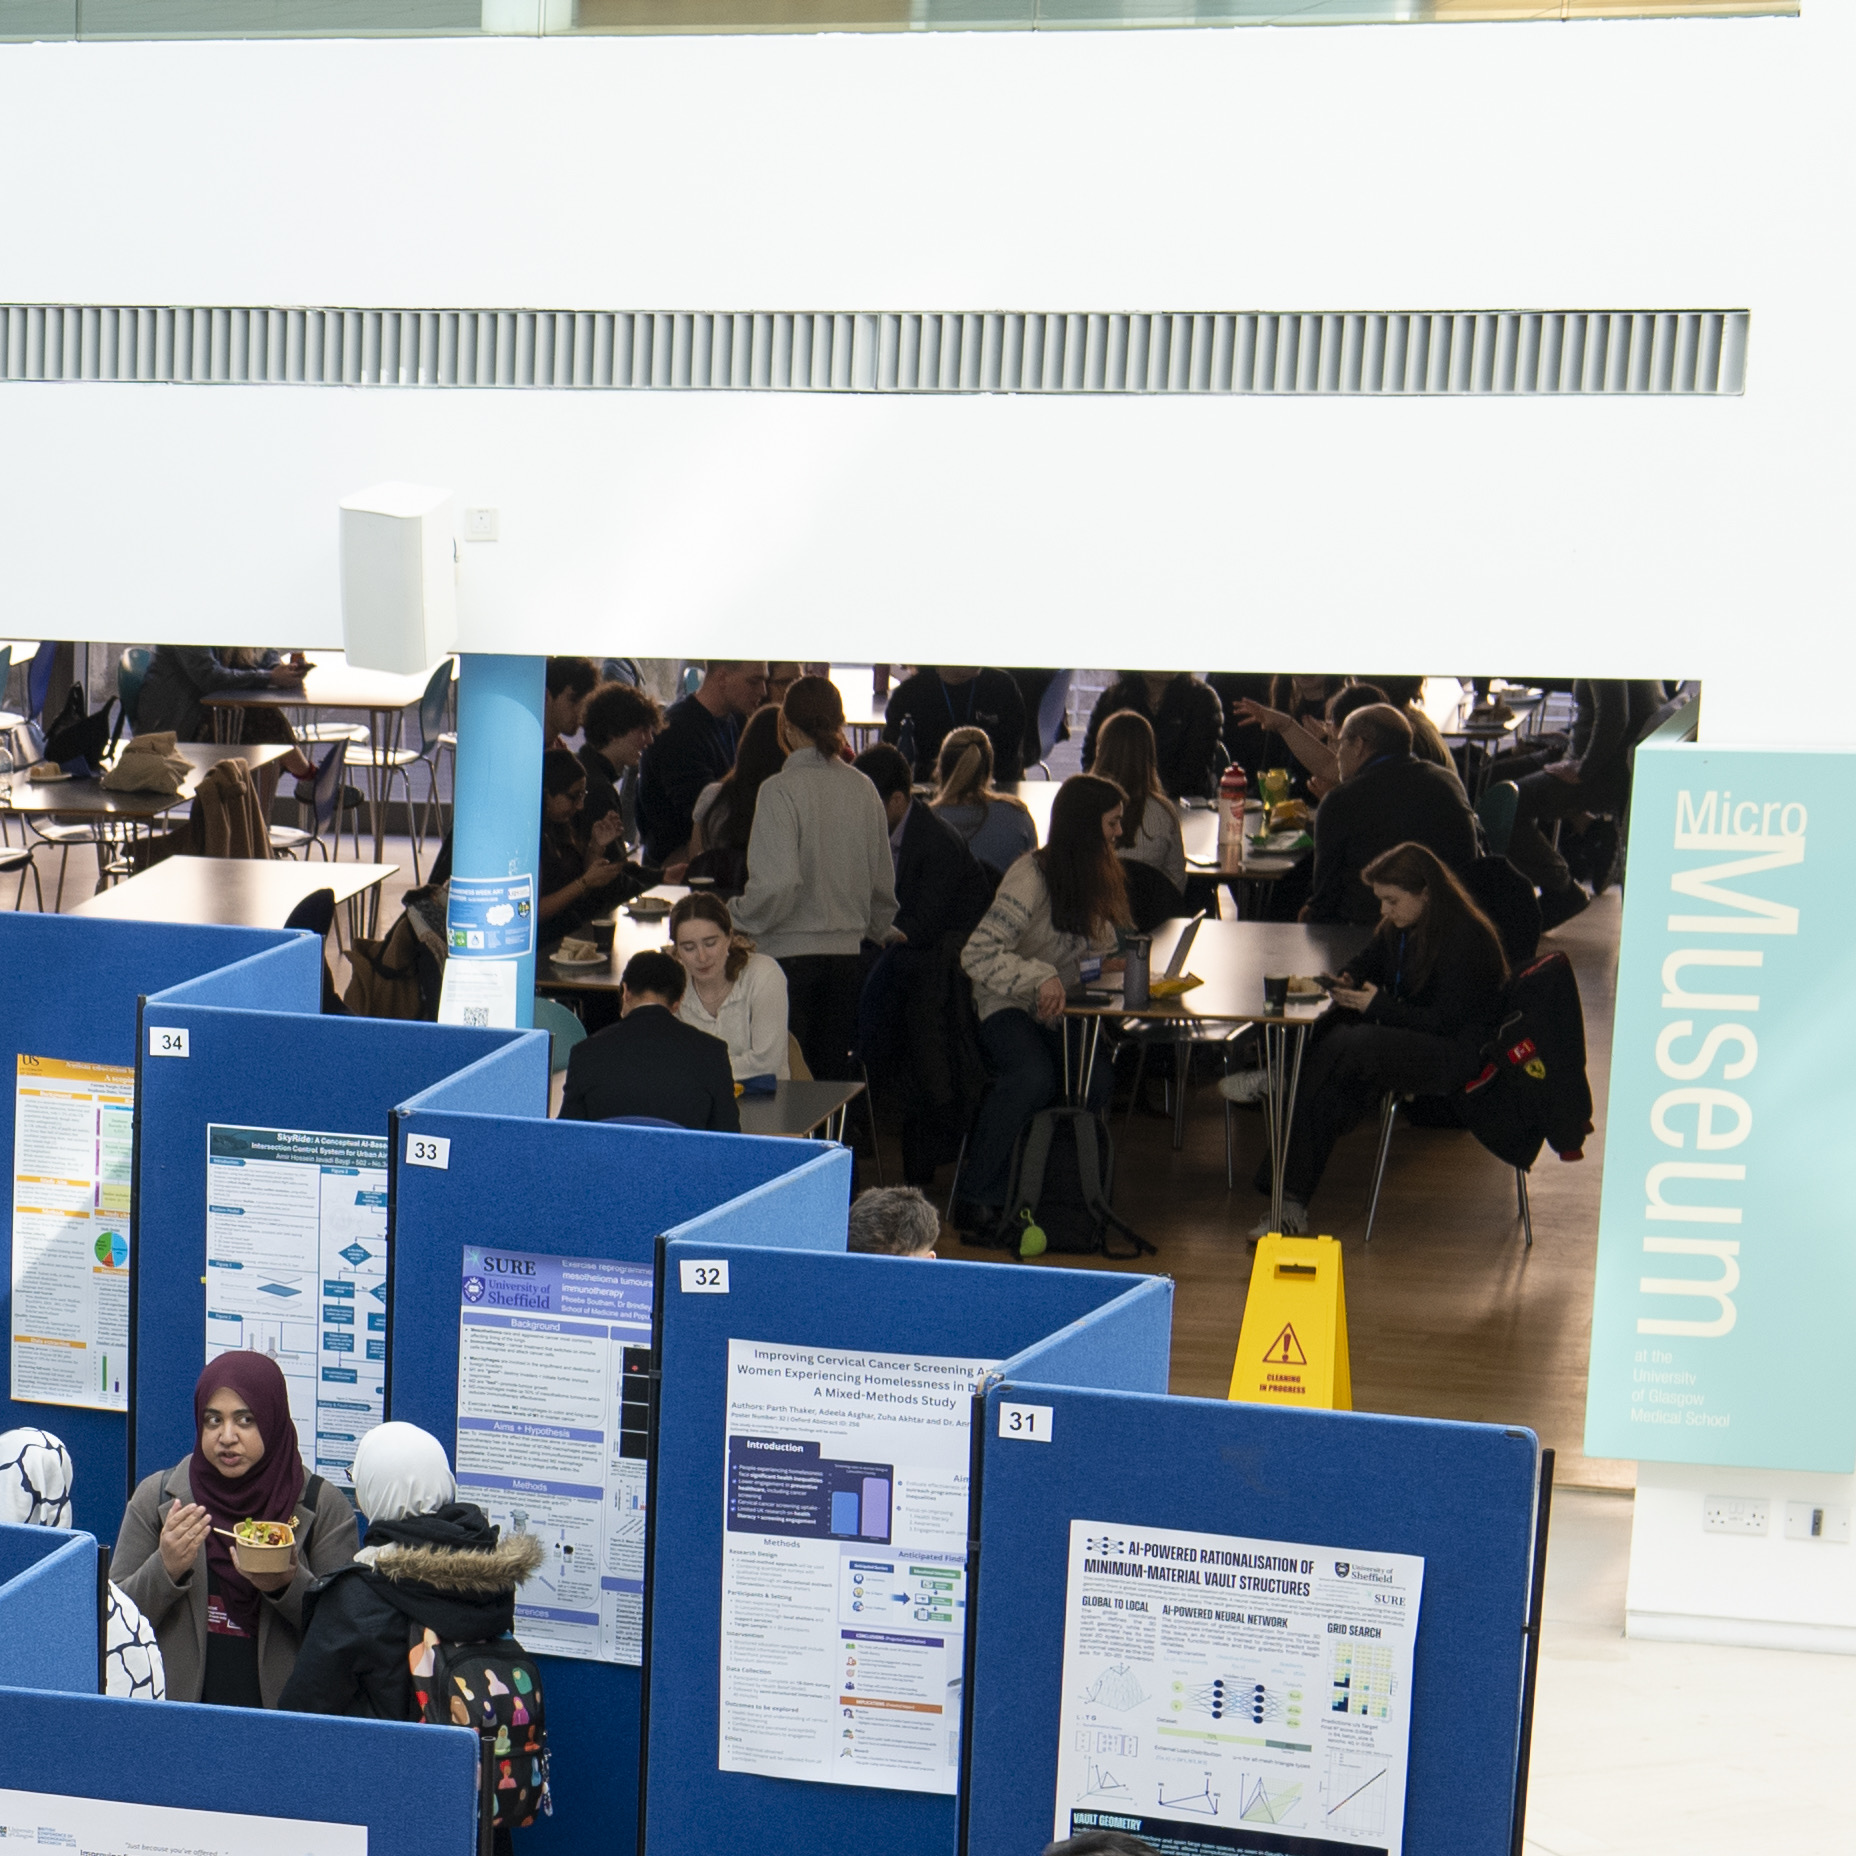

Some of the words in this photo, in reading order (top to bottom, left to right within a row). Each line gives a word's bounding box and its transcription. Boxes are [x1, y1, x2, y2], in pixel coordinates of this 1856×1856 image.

[1675, 789, 1809, 839] Micro
[162, 1035, 182, 1051] 34
[1636, 834, 1807, 1341] Museum
[277, 1133, 313, 1143] SkyRide:
[321, 1137, 360, 1148] Conceptual
[251, 1142, 292, 1152] Intersection
[292, 1145, 318, 1153] Control
[319, 1147, 345, 1157] System
[356, 1150, 376, 1158] Urban
[414, 1142, 436, 1160] 33
[483, 1256, 536, 1276] SURE
[561, 1259, 596, 1270] Exercise
[562, 1272, 618, 1284] mesothelioma
[695, 1268, 720, 1285] 32
[488, 1279, 538, 1294] University
[540, 1284, 551, 1293] of
[561, 1284, 624, 1299] immunotherapy
[487, 1292, 550, 1309] Sheffield
[510, 1318, 560, 1332] Background
[754, 1348, 814, 1365] Improving
[817, 1354, 866, 1368] Cervical
[868, 1359, 911, 1372] Cancer
[913, 1362, 974, 1378] Screening
[1634, 1349, 1648, 1365] at
[1650, 1349, 1673, 1365] the
[737, 1364, 782, 1377] Women
[785, 1368, 861, 1385] Experiencing
[864, 1374, 950, 1391] Homelessness
[953, 1380, 963, 1391] in
[1266, 1373, 1301, 1383] CLEANING
[1633, 1368, 1697, 1387] University
[1268, 1384, 1306, 1394] PROGRESS
[813, 1387, 822, 1397] A
[825, 1388, 918, 1405] Mixed-Methods
[921, 1395, 957, 1410] Study
[1631, 1389, 1645, 1404] of
[1648, 1390, 1705, 1409] Glasgow
[1008, 1412, 1036, 1433] 31
[1630, 1407, 1682, 1425] Medical
[1686, 1410, 1730, 1428] School
[493, 1421, 514, 1432] Aims
[524, 1425, 570, 1439] Hypothesis
[746, 1440, 804, 1453] Introduction
[512, 1479, 548, 1492] Methods
[763, 1538, 801, 1548] Methods
[1128, 1540, 1197, 1563] AI-POWERED
[1200, 1549, 1298, 1574] RATIONALISATION
[1300, 1559, 1315, 1575] OF
[1084, 1557, 1201, 1586] MINIMUM-MATERIAL
[1204, 1571, 1236, 1589] VAULT
[1238, 1574, 1311, 1597] STRUCTURES
[1081, 1595, 1113, 1609] GLOBAL
[1114, 1598, 1124, 1610] TO
[1125, 1599, 1150, 1613] LOCAL
[1162, 1603, 1213, 1621] AI-POWERED
[1214, 1609, 1246, 1624] NEURAL
[1247, 1611, 1289, 1629] NETWORK
[1326, 1622, 1347, 1636] GRID
[1349, 1625, 1382, 1639] SEARCH
[1073, 1812, 1097, 1827] VAULT
[1098, 1814, 1142, 1831] GEOMETRY
